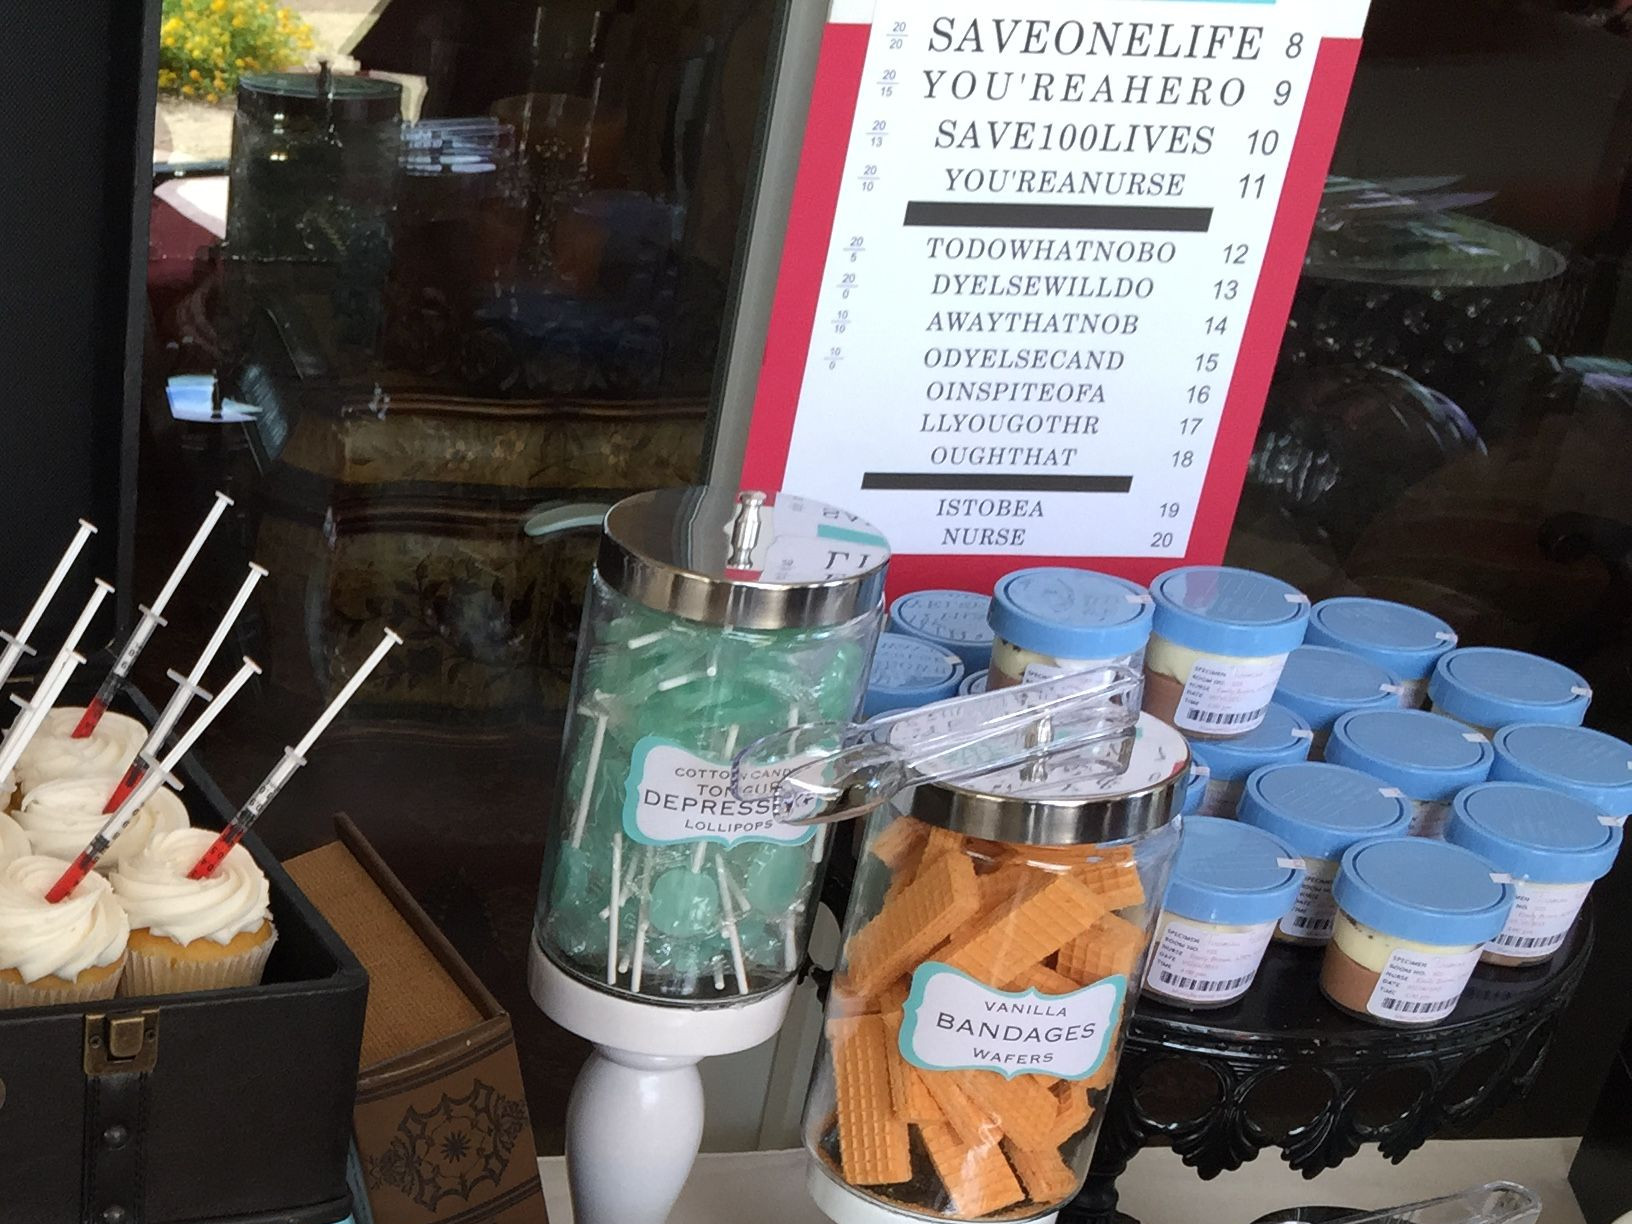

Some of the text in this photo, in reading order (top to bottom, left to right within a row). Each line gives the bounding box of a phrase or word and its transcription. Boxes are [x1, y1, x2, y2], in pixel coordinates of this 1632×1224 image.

[893, 21, 906, 32] 20
[889, 39, 903, 49] 20
[928, 16, 1303, 60] SAVEONELIFE 8
[882, 69, 896, 80] 20
[923, 70, 1291, 107] YOU'REAHERO 9
[872, 120, 886, 131] 20
[935, 119, 1279, 156] SAVE100LIVES 10
[864, 165, 877, 175] 20
[945, 168, 1266, 199] YOU'REANURSE 11
[850, 236, 864, 247] 20
[926, 238, 1248, 265] TODOWHATNOBO 12
[842, 273, 856, 283] 20
[931, 274, 1238, 300] DYELSEWILLDO 13
[925, 311, 1228, 336] AWAYTHATNOB 14
[924, 348, 1219, 373] ODYELSECAND 15
[926, 382, 1211, 404] OINSPITEOFA 16
[920, 413, 1204, 436] LLYOUGOTHR 17
[930, 447, 1194, 468] OUGHTHAT 18
[936, 499, 1180, 518] ISTOBEA 19
[942, 528, 1173, 548] NURSE 20
[751, 768, 792, 780] CAND
[685, 819, 774, 833] LOLLIPOPS
[984, 1001, 1067, 1017] VANILLA
[936, 1012, 1096, 1043] BANDAGES
[972, 1047, 1055, 1065] WAFERS
